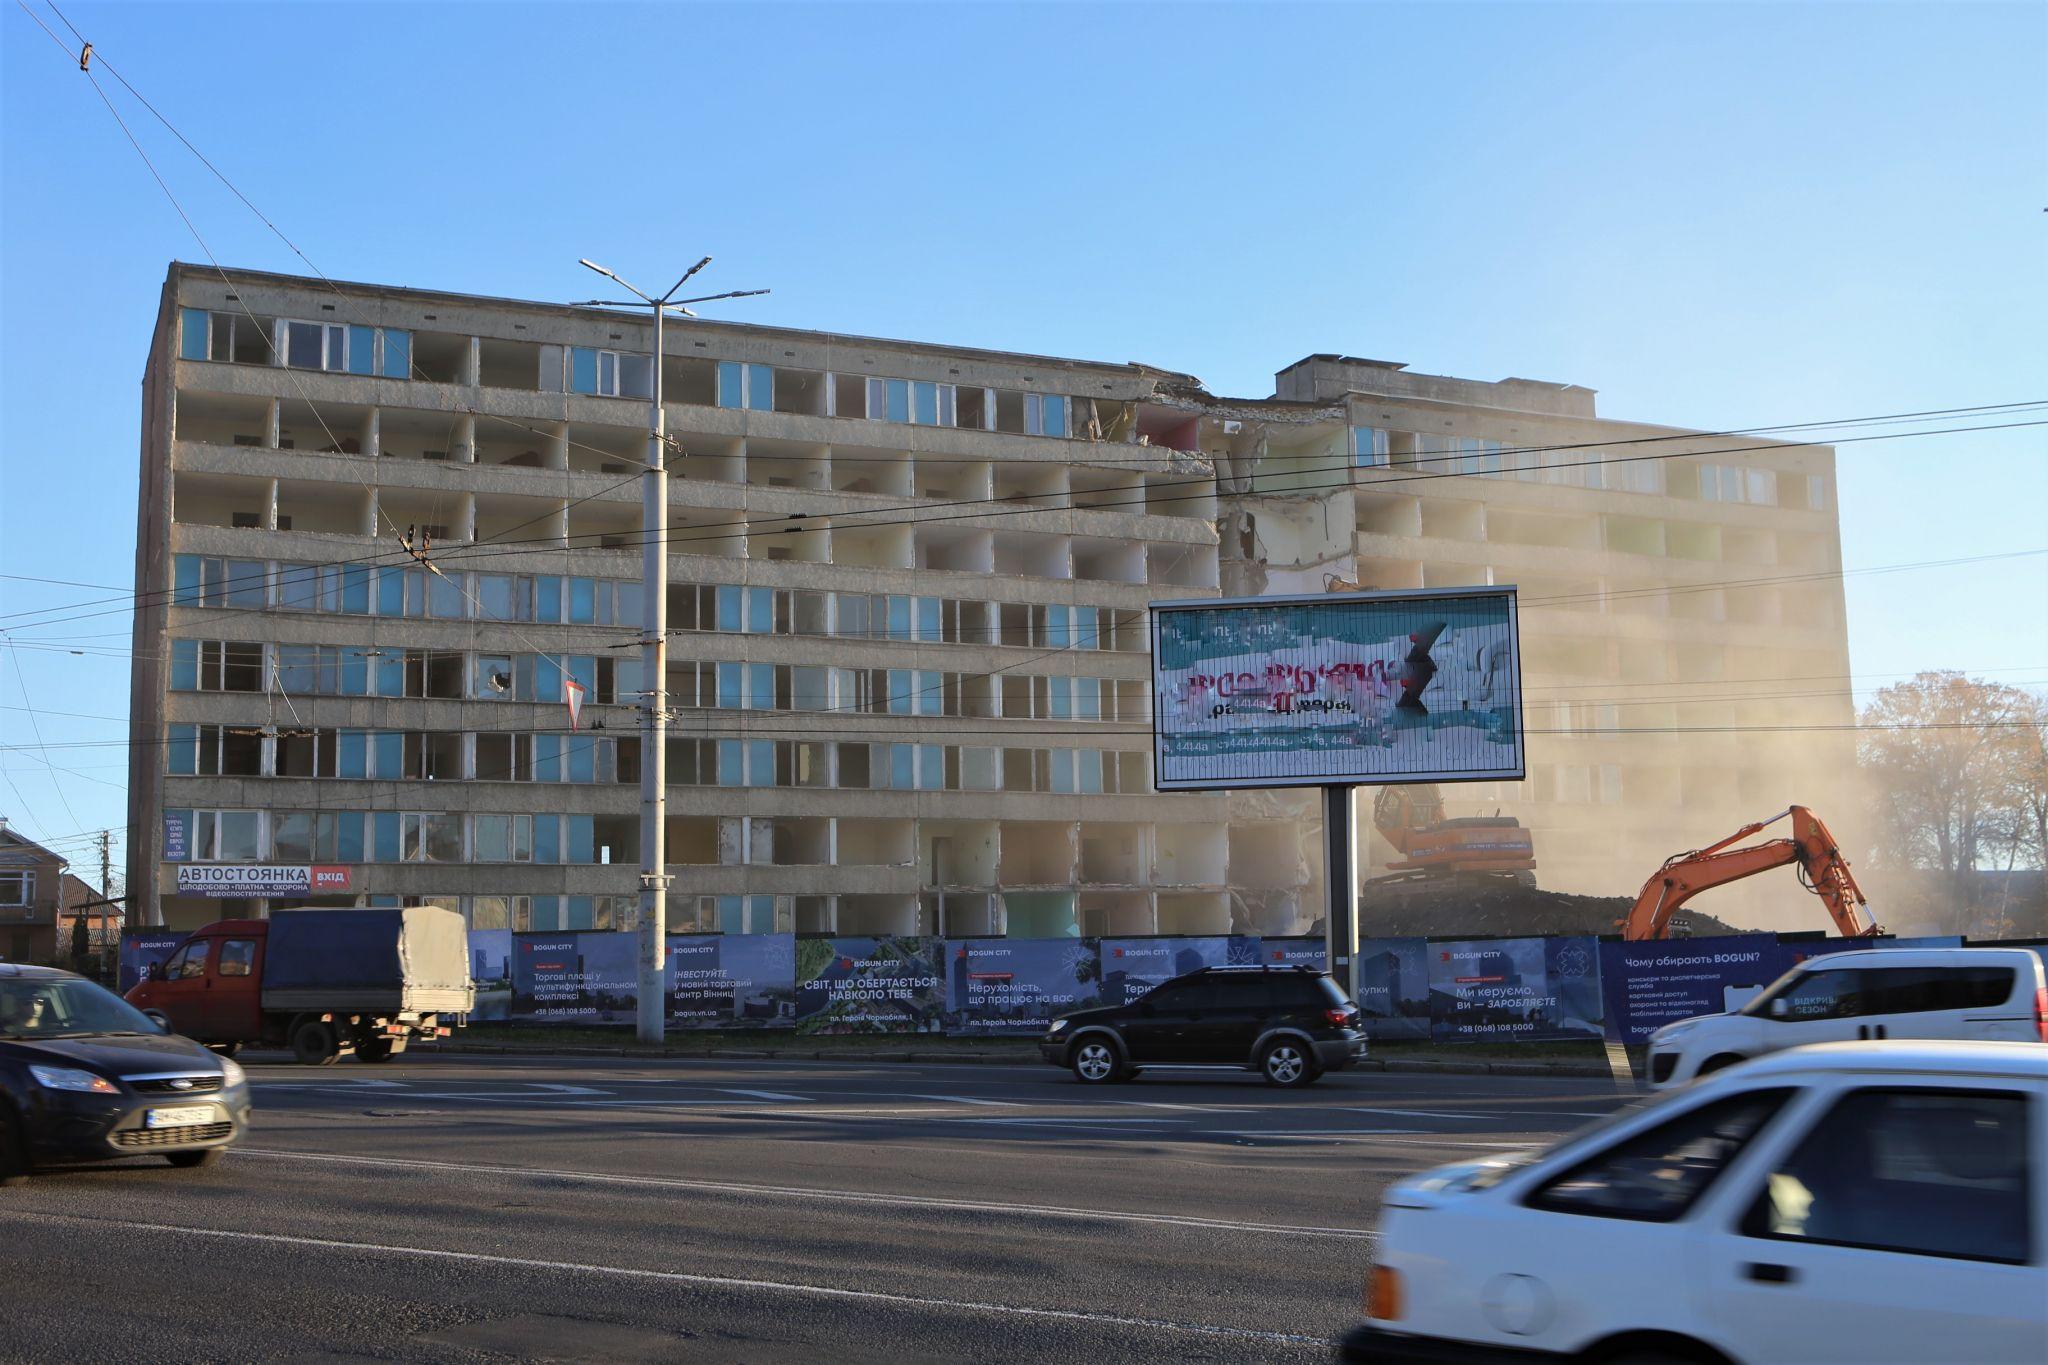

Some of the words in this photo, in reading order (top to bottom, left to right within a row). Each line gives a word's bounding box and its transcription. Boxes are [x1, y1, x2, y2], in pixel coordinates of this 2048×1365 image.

[179, 868, 308, 881] АВТОСТОЯНКА
[316, 872, 344, 882] ВХІД
[180, 884, 230, 892] ЦІЛОДОБОВО
[1626, 958, 1654, 968] Чому
[1656, 956, 1712, 967] обирають
[1714, 952, 1760, 963] BOGUN?
[534, 973, 566, 982] Торгові
[568, 972, 594, 981] площі
[674, 969, 727, 978] ІНВЕСТУЙТЕ
[534, 982, 637, 992] мультифункціональном
[710, 978, 752, 989] торговий
[804, 980, 832, 990] СВІТ,
[834, 979, 854, 989] ЩО
[857, 977, 937, 988] ОБЕРТАЄТЬСЯ
[969, 982, 1042, 994] Нерухомість,
[534, 992, 579, 1001] комплексі
[674, 992, 701, 1000] центр
[704, 989, 736, 999] Вінниці
[829, 990, 884, 1000] НАВКОЛО
[887, 990, 913, 999] ТЕБЕ
[1456, 988, 1475, 998] Ми
[1478, 987, 1534, 998] керуємо,
[969, 996, 985, 1005] що
[988, 995, 1033, 1005] працює
[1053, 994, 1073, 1002] вас
[1488, 997, 1556, 1008] ЗАРОБЛЯЄТЕ
[1794, 996, 1836, 1005] ВІДКРИВ
[1474, 1024, 1495, 1033] (068)
